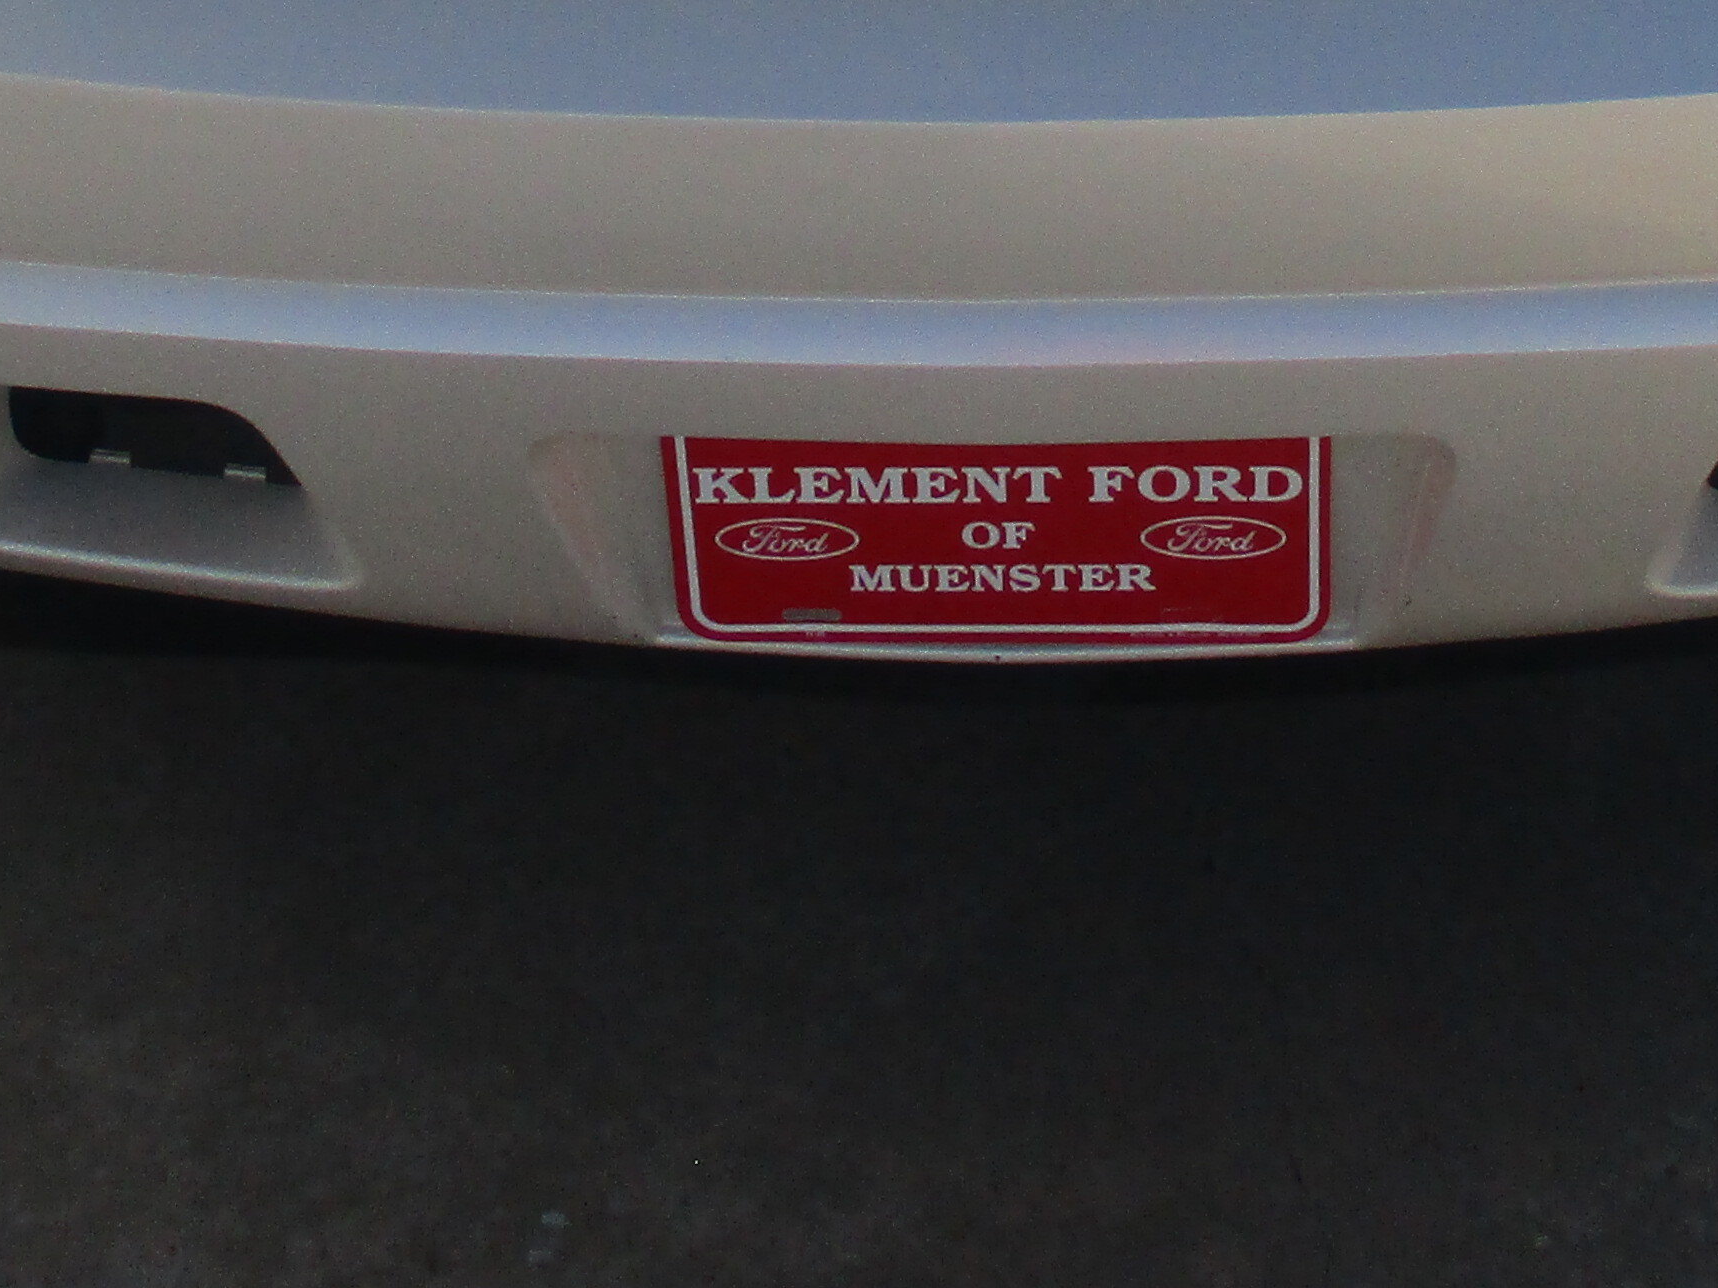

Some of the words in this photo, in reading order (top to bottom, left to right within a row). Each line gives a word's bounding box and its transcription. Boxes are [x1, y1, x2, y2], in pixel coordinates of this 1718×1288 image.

[692, 466, 1062, 504] KLEMENT
[1087, 465, 1304, 504] FORD
[741, 524, 829, 554] Ford
[962, 521, 1036, 550] OF
[1167, 523, 1257, 553] Ford
[849, 563, 1157, 592] MUENSTER
